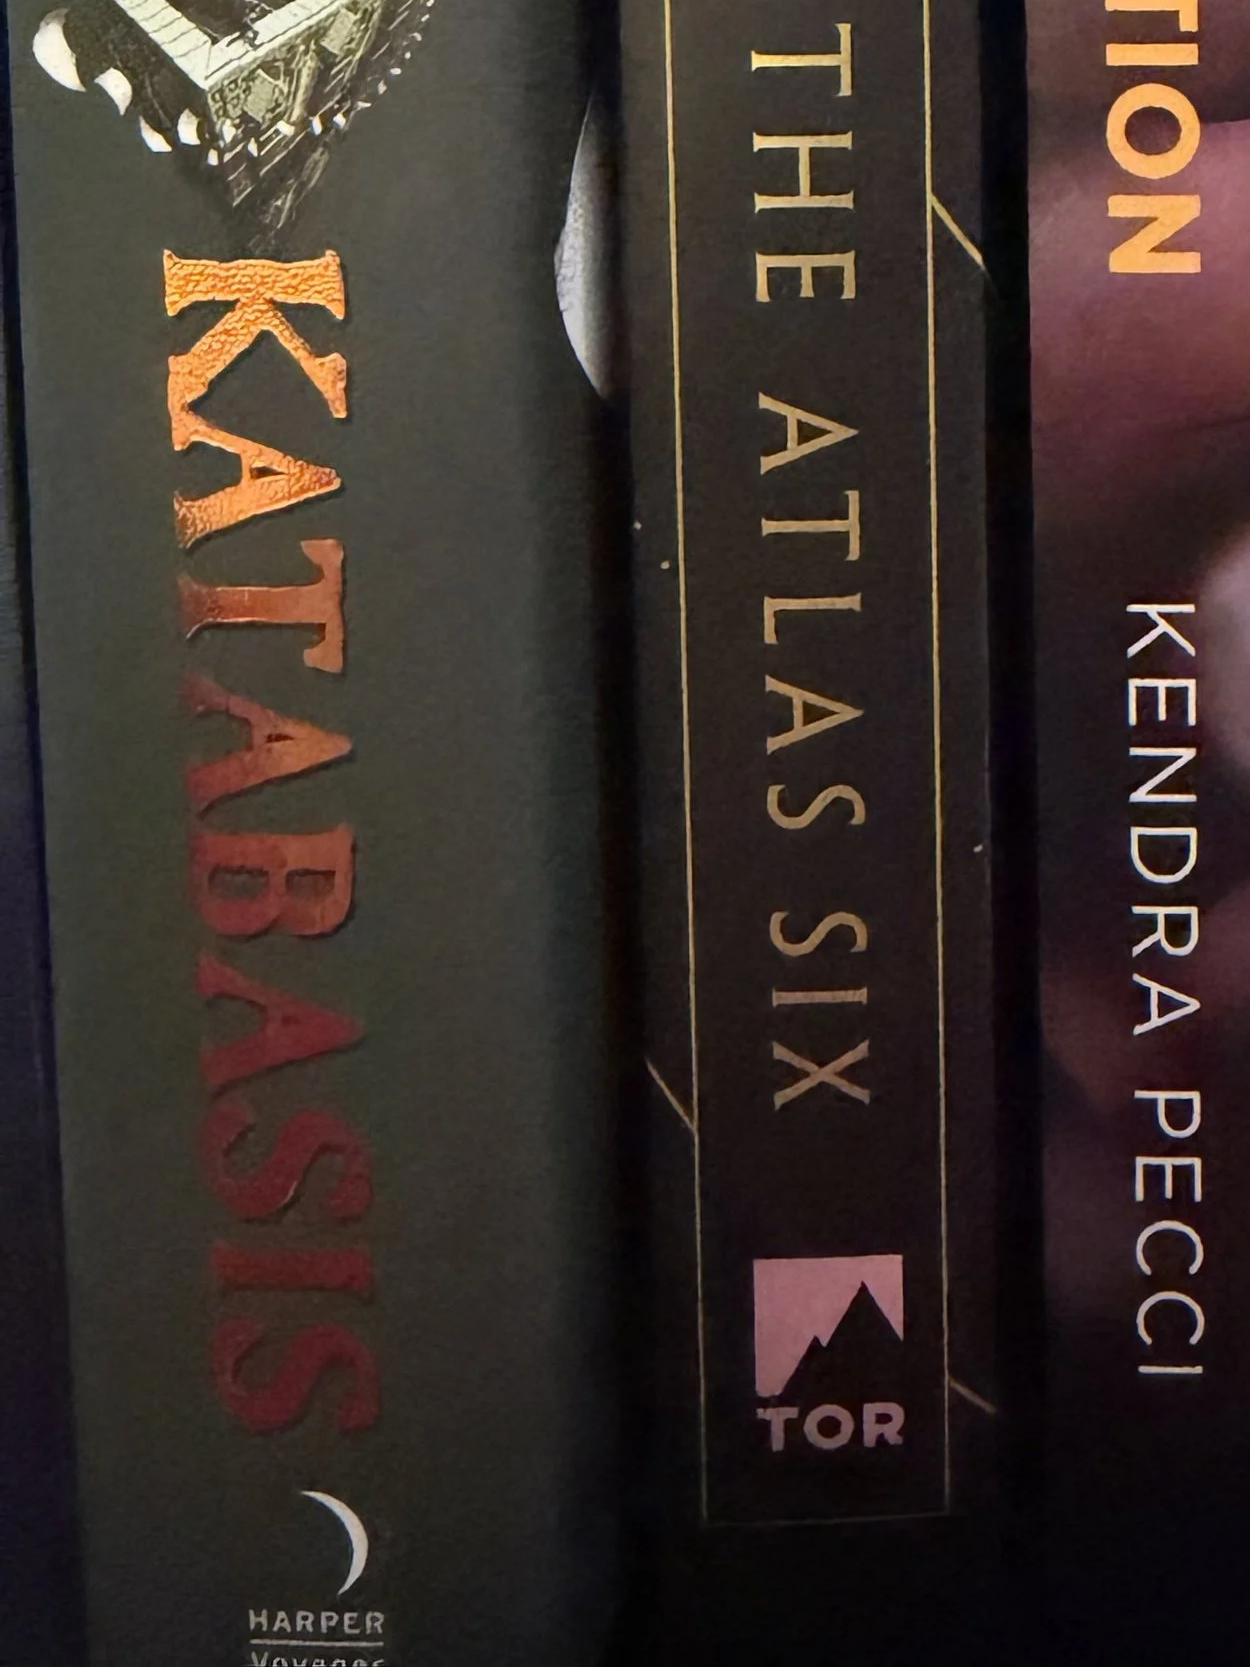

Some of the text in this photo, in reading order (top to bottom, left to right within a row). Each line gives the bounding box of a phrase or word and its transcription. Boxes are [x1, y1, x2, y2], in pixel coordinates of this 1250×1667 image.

[749, 22, 857, 303] THE
[758, 387, 865, 831] ATLAS
[162, 249, 381, 1434] KATABASIS
[769, 909, 871, 1111] SIX
[1125, 603, 1204, 1375] KENDRA PECCI
[756, 1403, 904, 1453] TOR
[249, 1608, 385, 1635] HARPER
